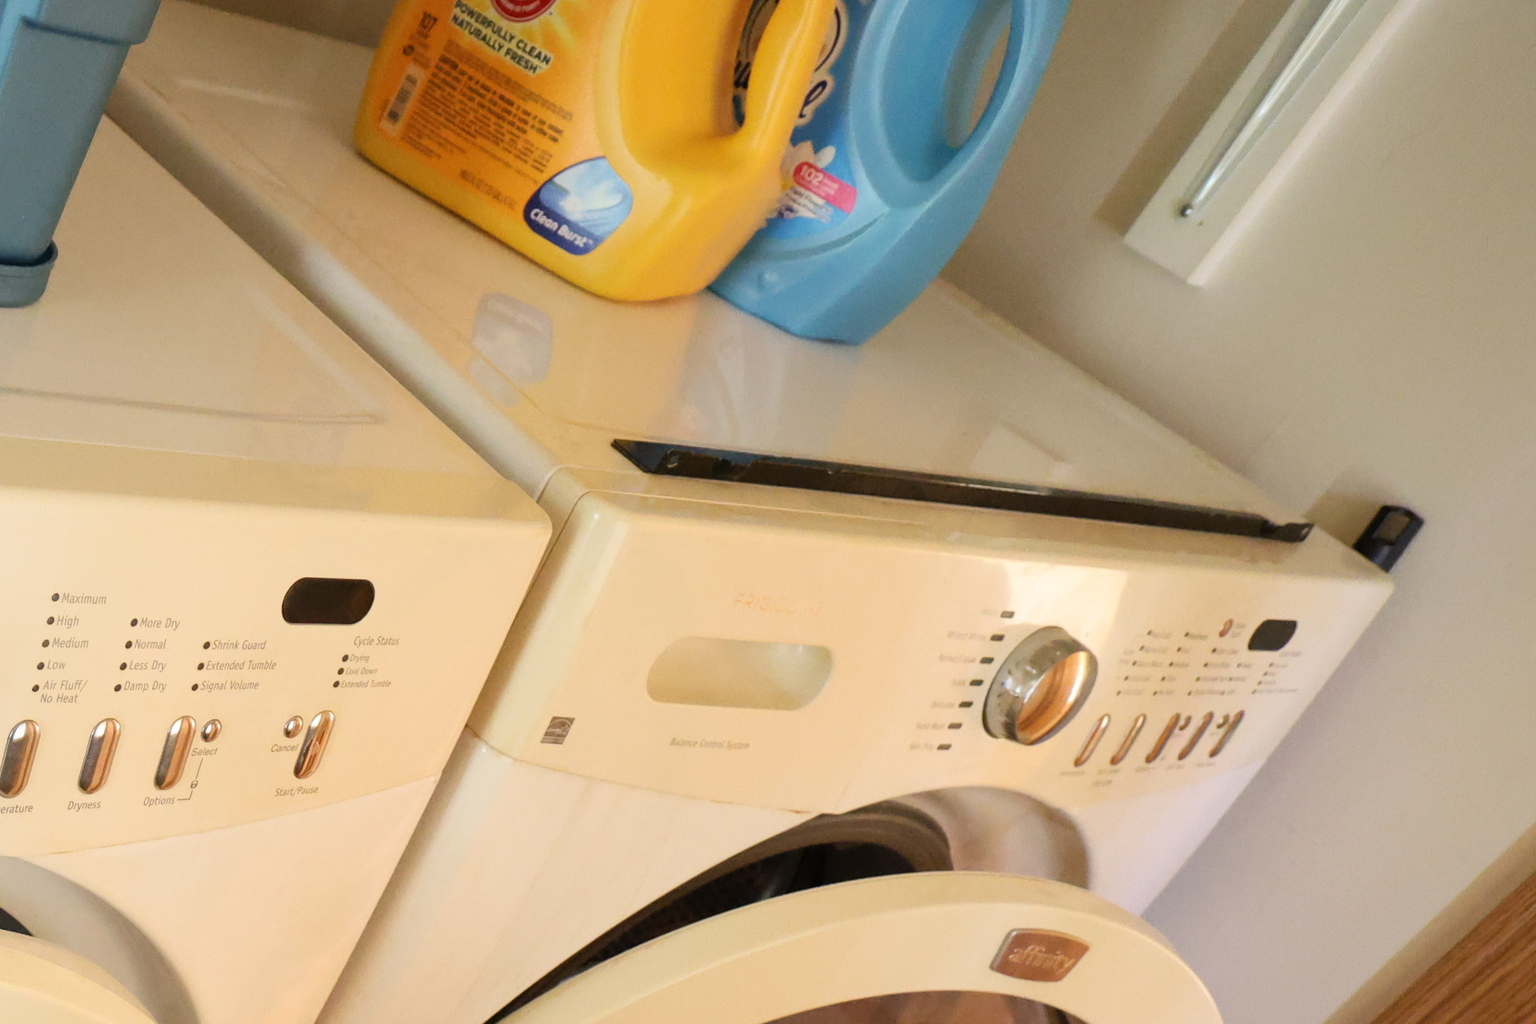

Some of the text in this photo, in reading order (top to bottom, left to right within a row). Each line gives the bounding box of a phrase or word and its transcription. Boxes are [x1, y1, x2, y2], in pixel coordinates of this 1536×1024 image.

[451, 14, 505, 54] NATURALLY
[454, 0, 552, 66] POWERFULLY CLEAN
[800, 164, 824, 185] 102
[530, 208, 559, 232] Clean
[61, 592, 107, 606] Maximum
[56, 615, 80, 629] High
[139, 617, 181, 632] More Dry
[52, 636, 89, 649] Medium
[134, 638, 167, 650] Normal
[211, 639, 267, 651] Shrink Guard
[353, 635, 400, 648] Cycle Status
[46, 659, 67, 671] Low
[128, 660, 167, 674] Less Dry
[205, 659, 277, 672] Extended Tumble
[43, 679, 88, 692] Air Fluff/
[123, 680, 167, 695] Damp Dry
[200, 679, 260, 693] Signal Volume
[40, 692, 79, 704] No Heat
[191, 746, 218, 757] Select
[270, 742, 299, 754] Cancel
[274, 785, 319, 798] Start/Pause
[67, 799, 101, 812] Dryness
[143, 794, 176, 807] Options
